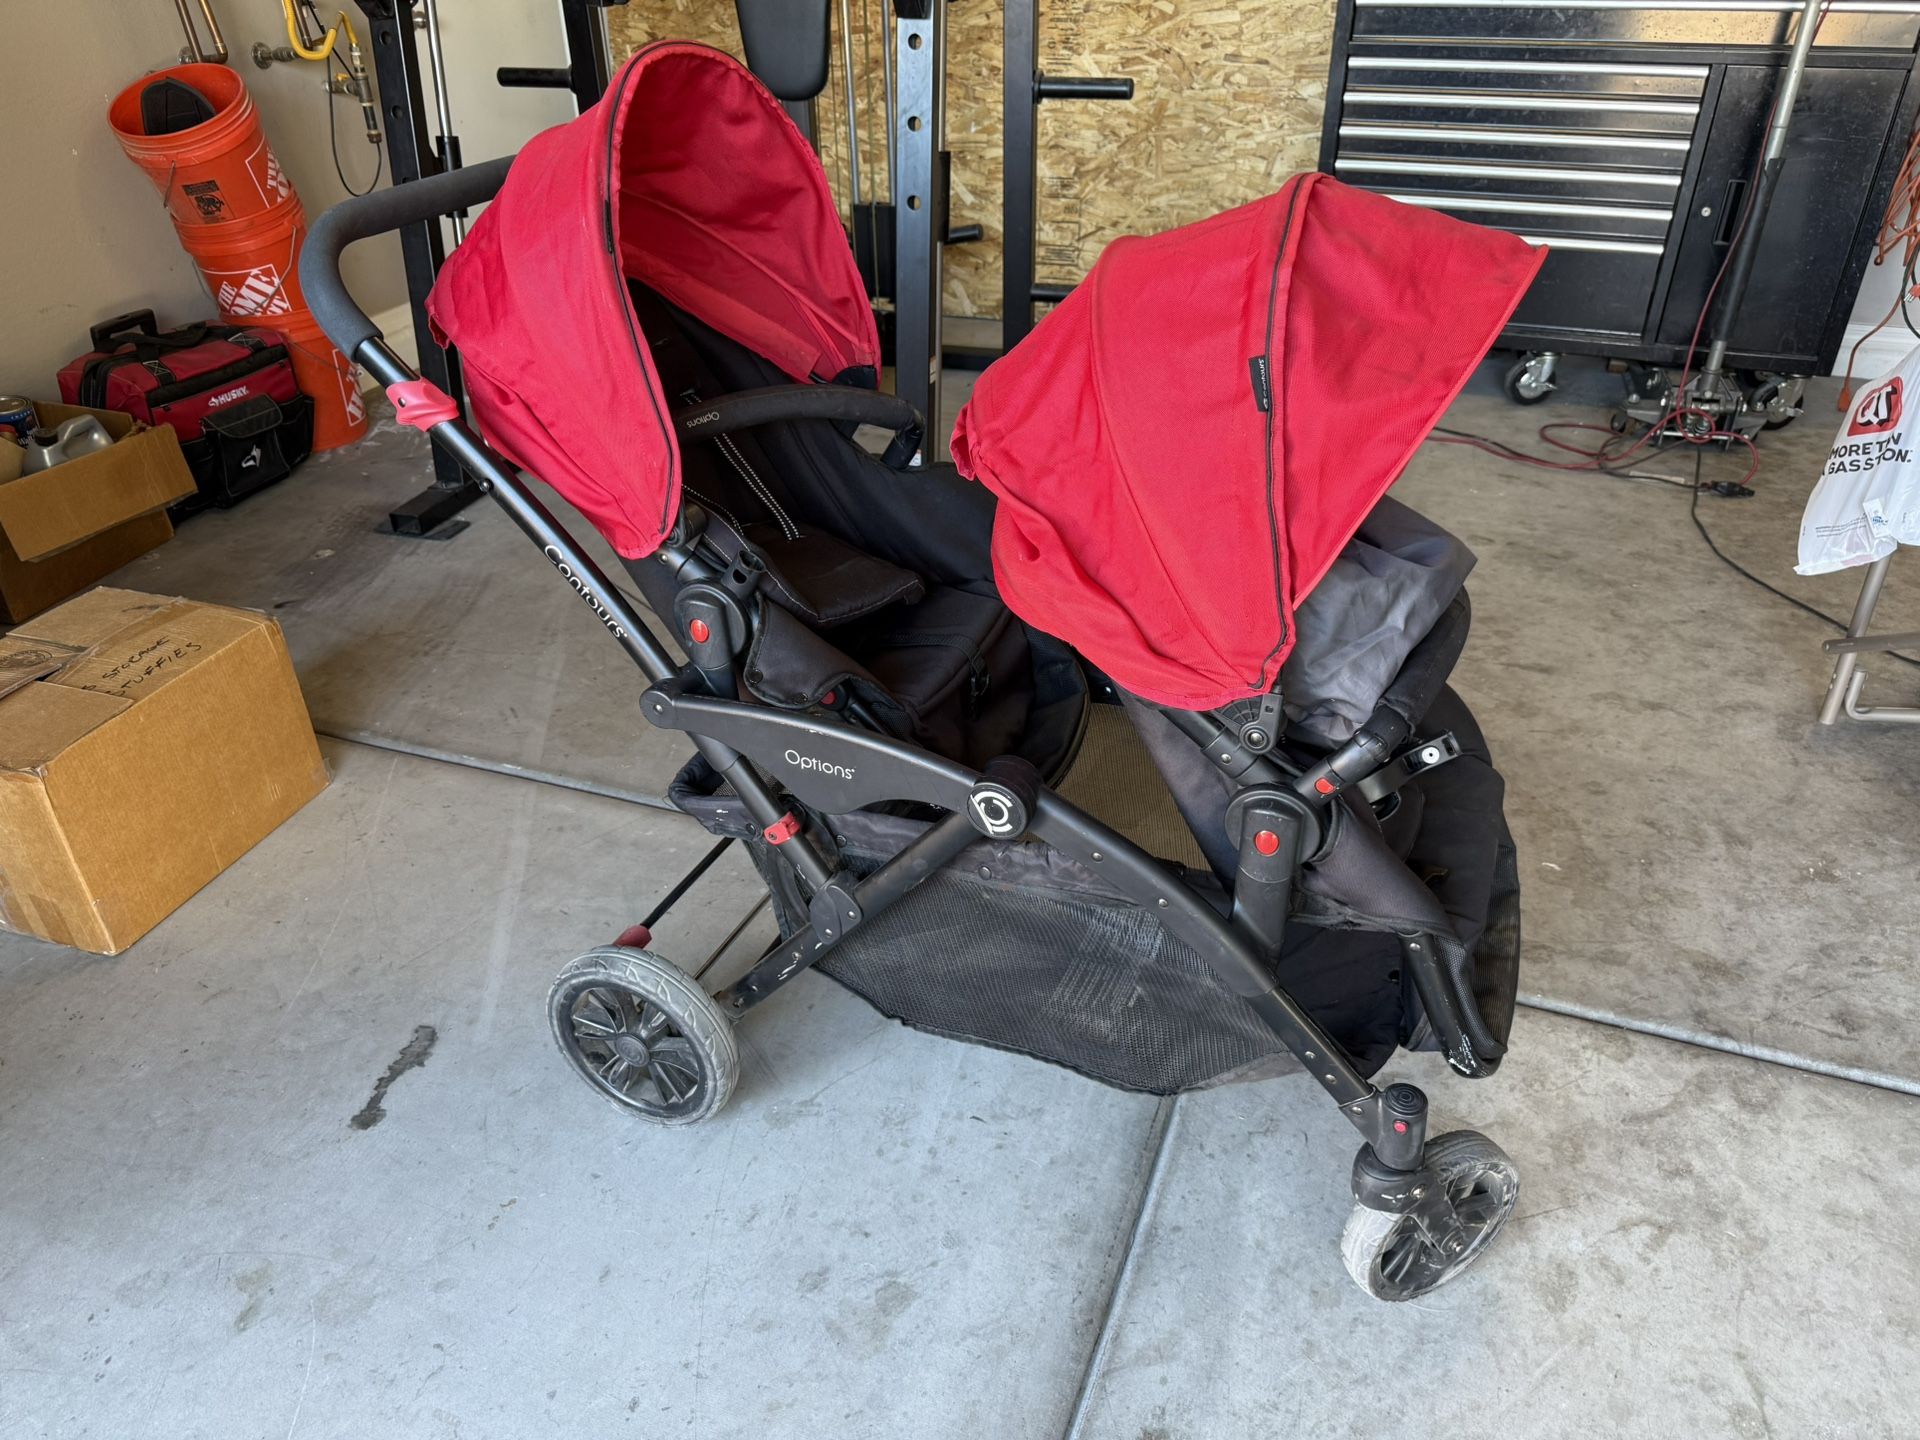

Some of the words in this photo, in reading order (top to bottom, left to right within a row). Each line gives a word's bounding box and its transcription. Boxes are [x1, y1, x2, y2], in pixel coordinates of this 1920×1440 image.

[219, 281, 238, 311] THE
[218, 385, 249, 405] HUSKY
[1857, 385, 1895, 426] QT
[686, 411, 720, 428] Options
[1829, 443, 1873, 460] MORE
[1828, 460, 1861, 475] GAS
[545, 545, 627, 638] Contours
[784, 749, 854, 780] Options
